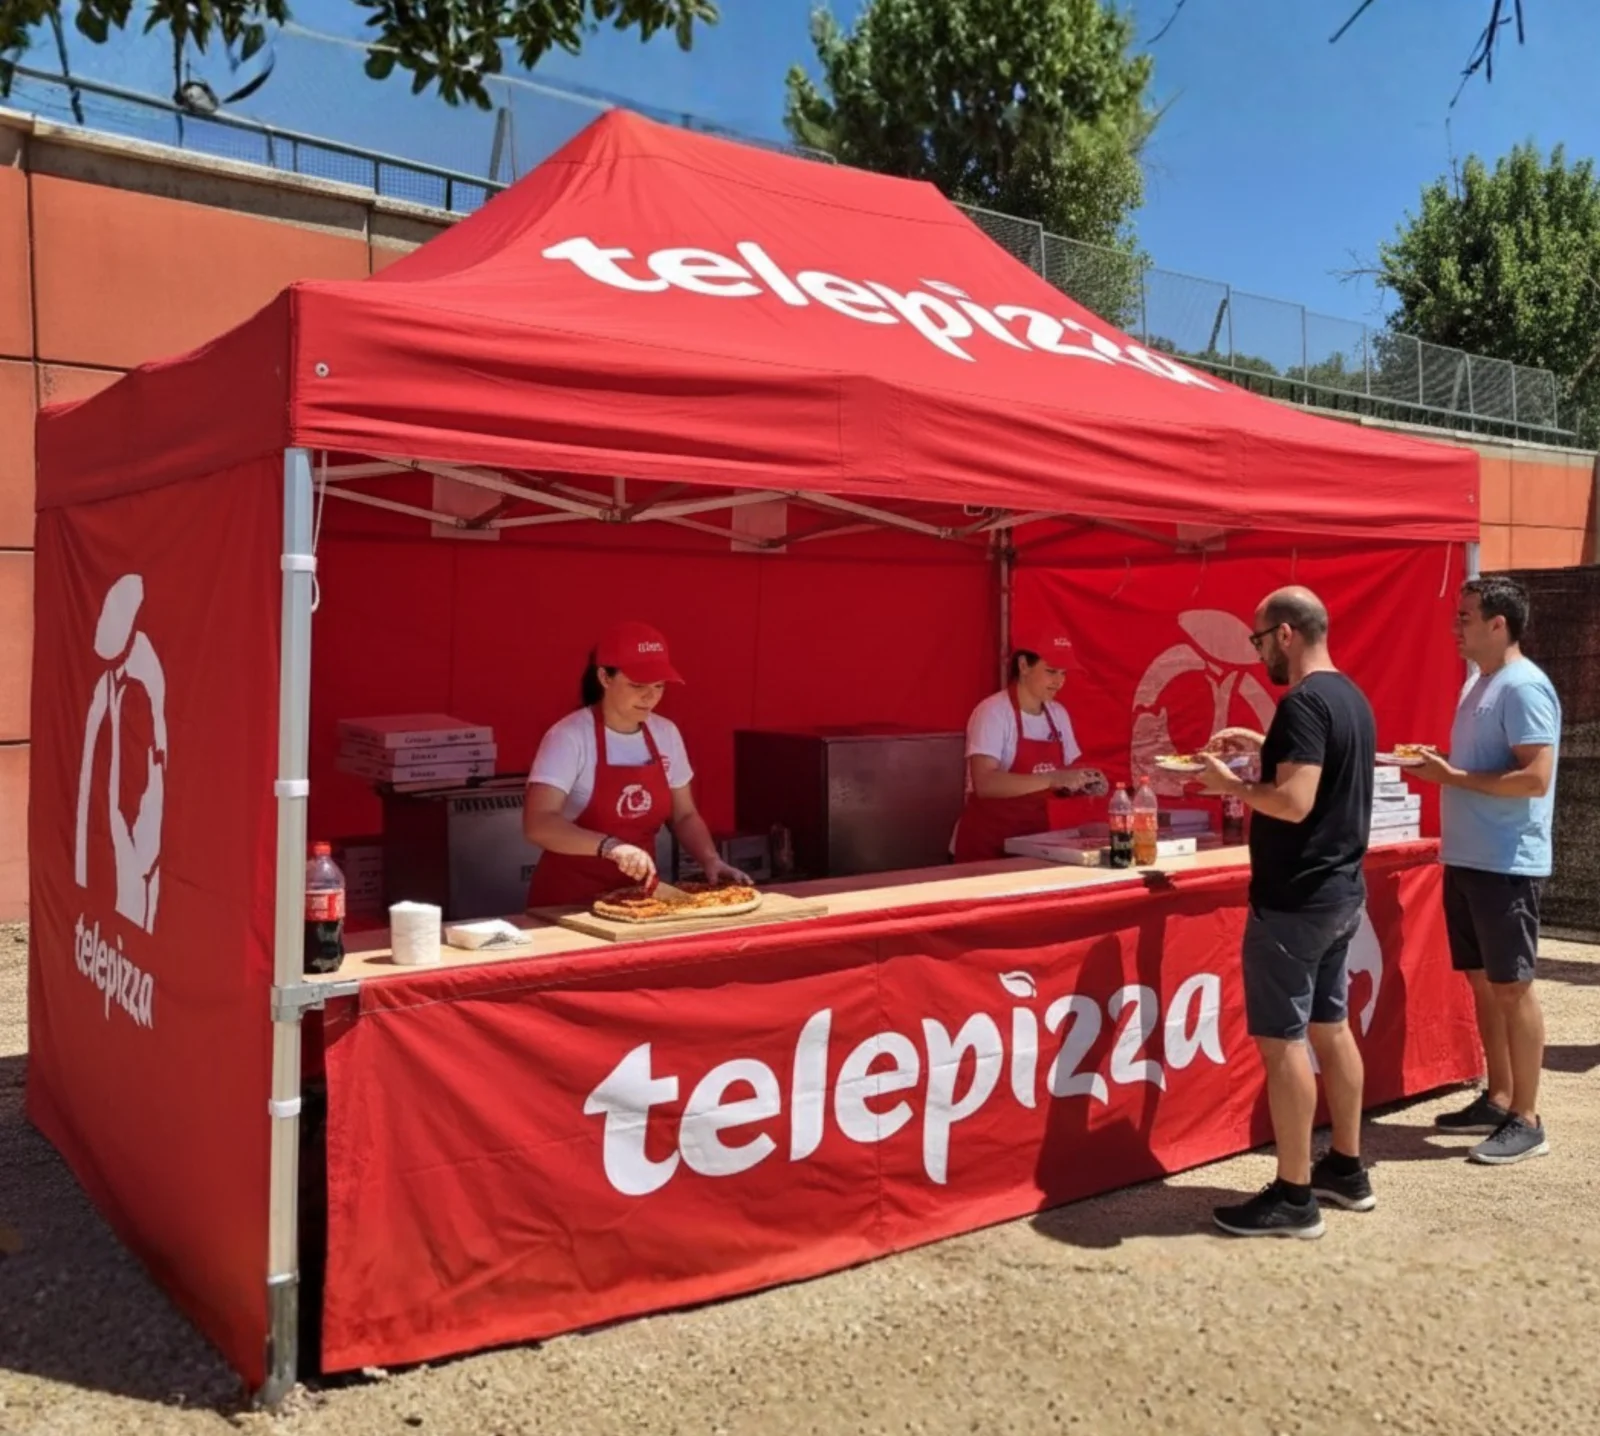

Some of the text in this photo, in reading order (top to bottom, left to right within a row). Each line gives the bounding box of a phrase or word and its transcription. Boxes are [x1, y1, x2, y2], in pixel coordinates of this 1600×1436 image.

[542, 236, 1224, 393] telepizza
[75, 912, 154, 1029] telepizza
[583, 971, 1227, 1196] telepizza
